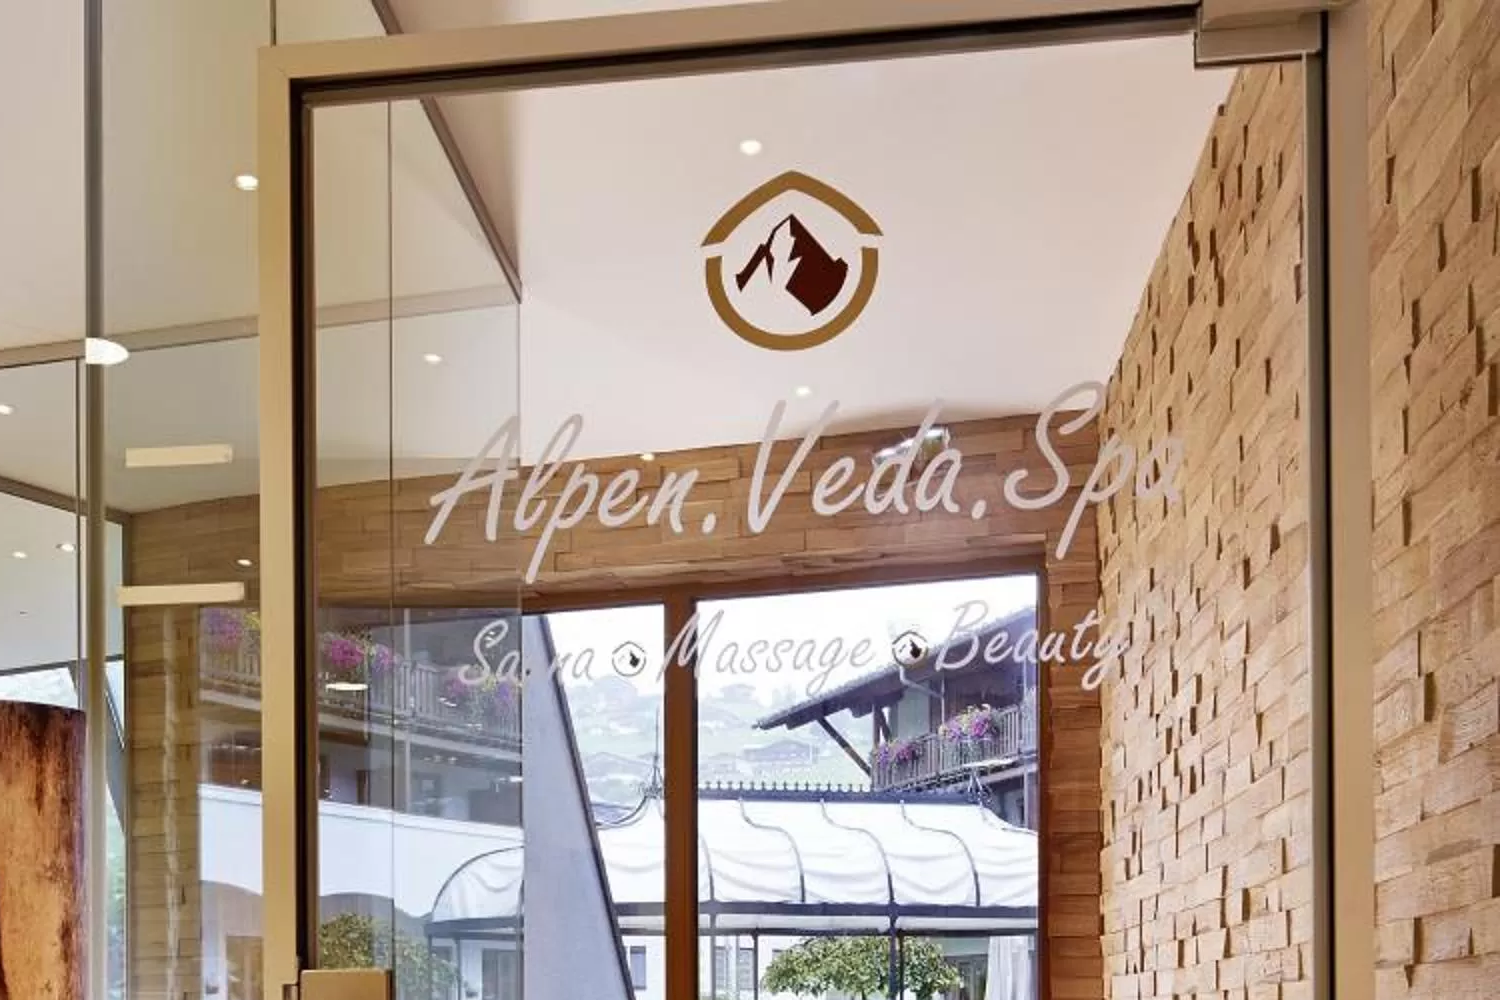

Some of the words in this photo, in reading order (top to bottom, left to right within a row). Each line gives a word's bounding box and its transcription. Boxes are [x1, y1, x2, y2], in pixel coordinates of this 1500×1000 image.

[458, 619, 595, 686] Sana
[655, 608, 875, 701] Massage
[934, 599, 1129, 691] Beauty
